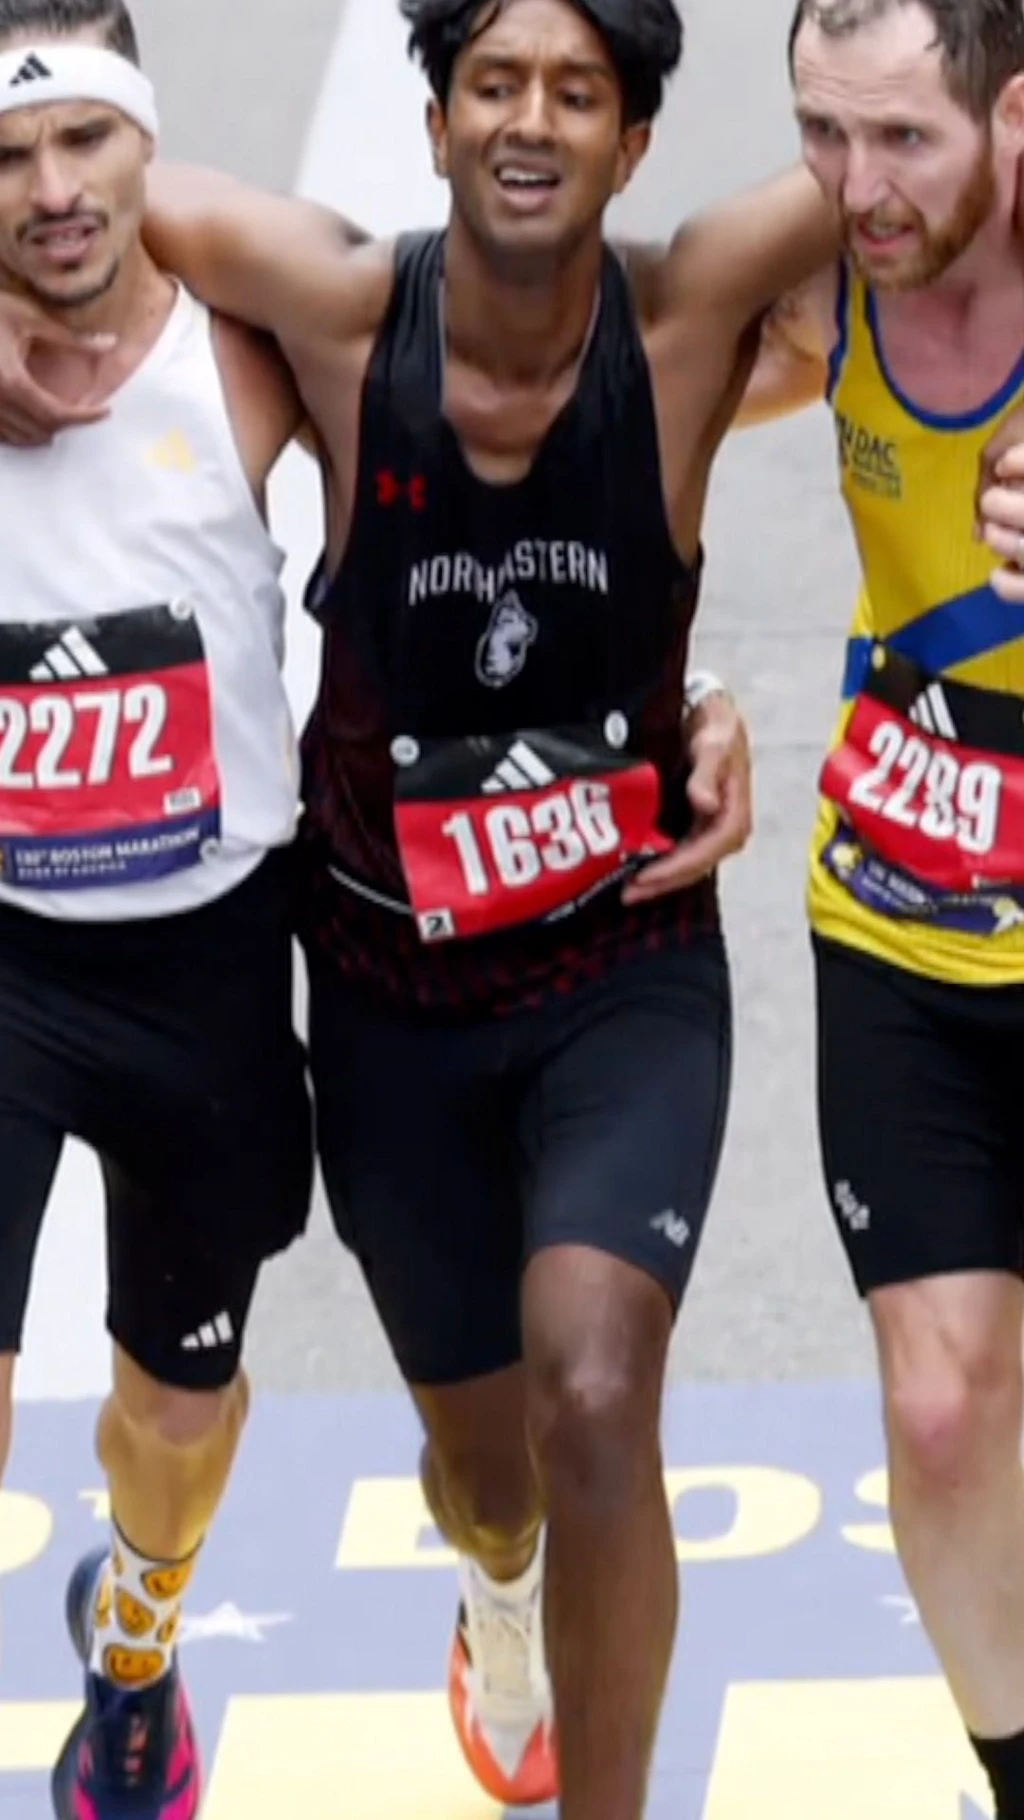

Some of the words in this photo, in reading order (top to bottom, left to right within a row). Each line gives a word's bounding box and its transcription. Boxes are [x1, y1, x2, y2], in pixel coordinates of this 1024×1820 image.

[0, 682, 174, 790] 2272
[847, 720, 1003, 856] 2289
[441, 778, 622, 897] 1636
